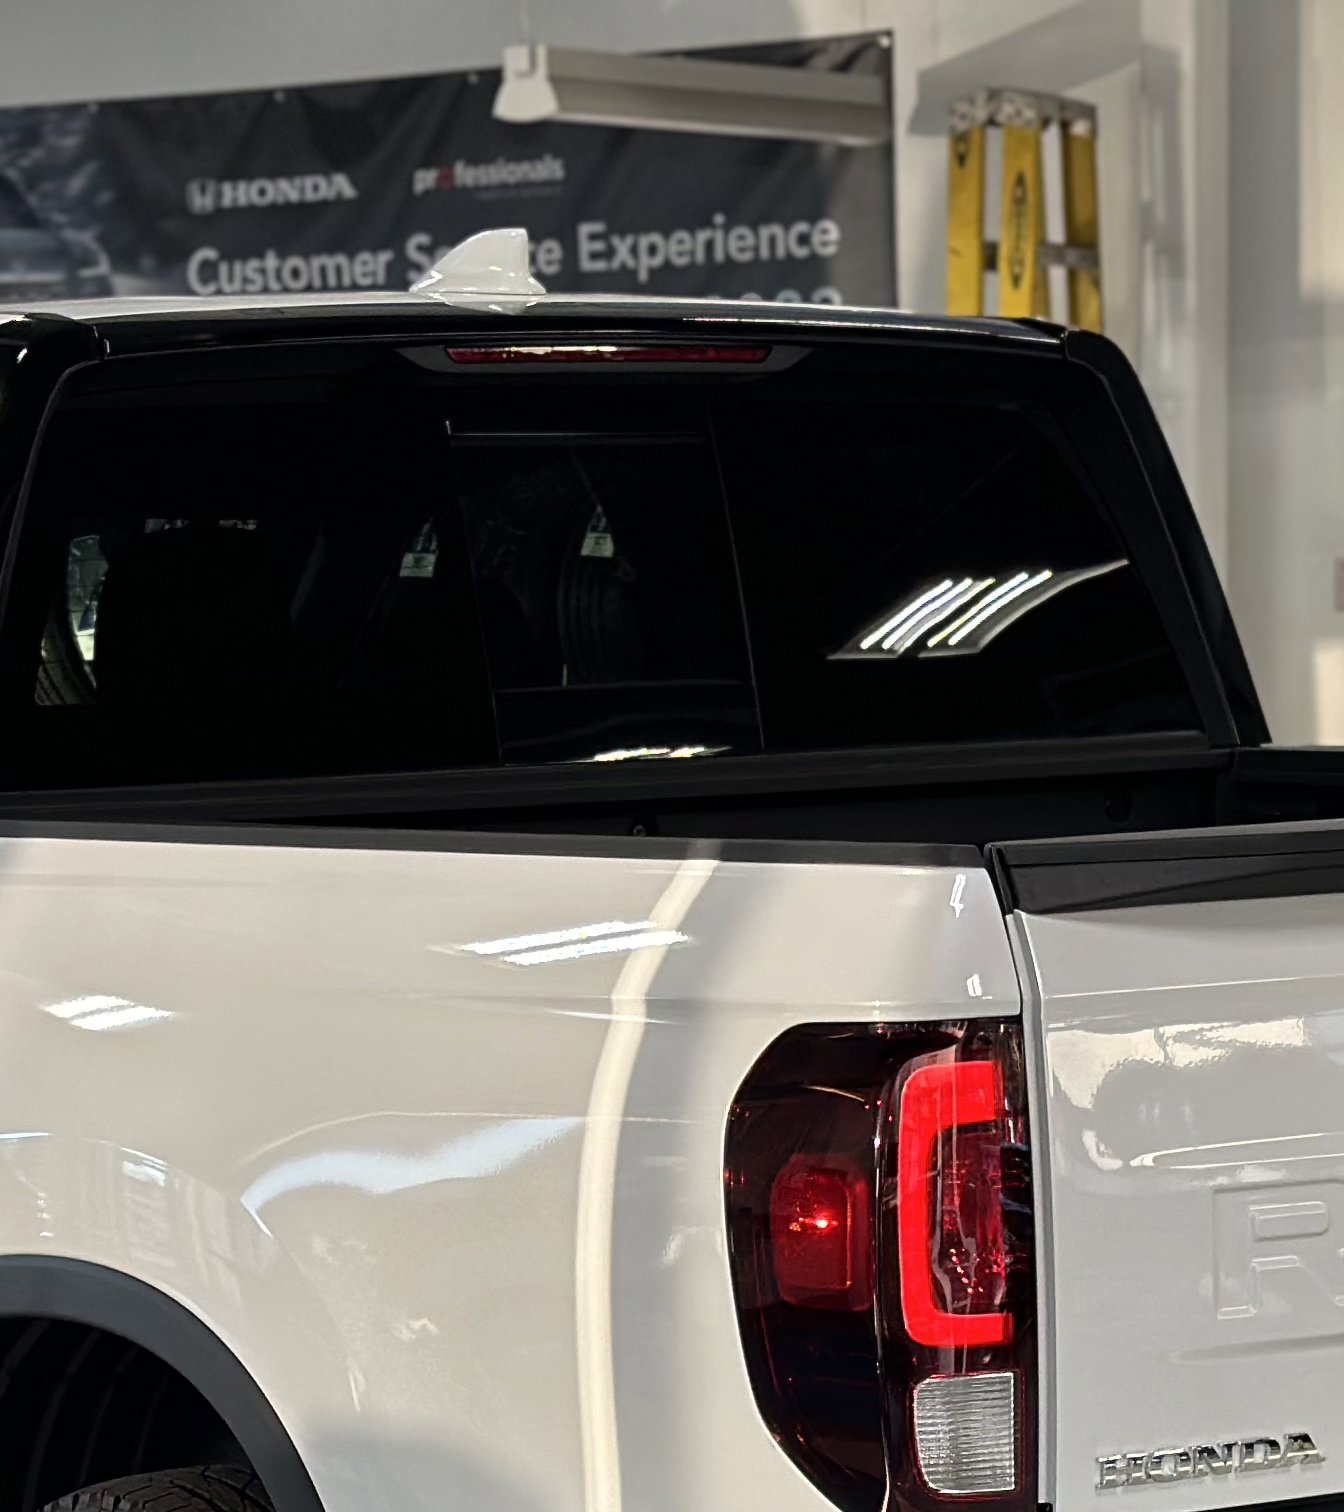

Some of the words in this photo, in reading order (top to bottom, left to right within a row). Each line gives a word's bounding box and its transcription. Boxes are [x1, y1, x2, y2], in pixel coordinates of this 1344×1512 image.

[220, 172, 359, 210] HONDA
[186, 246, 396, 295] Customer
[576, 211, 842, 285] Experience
[1095, 1432, 1326, 1490] HONDA
